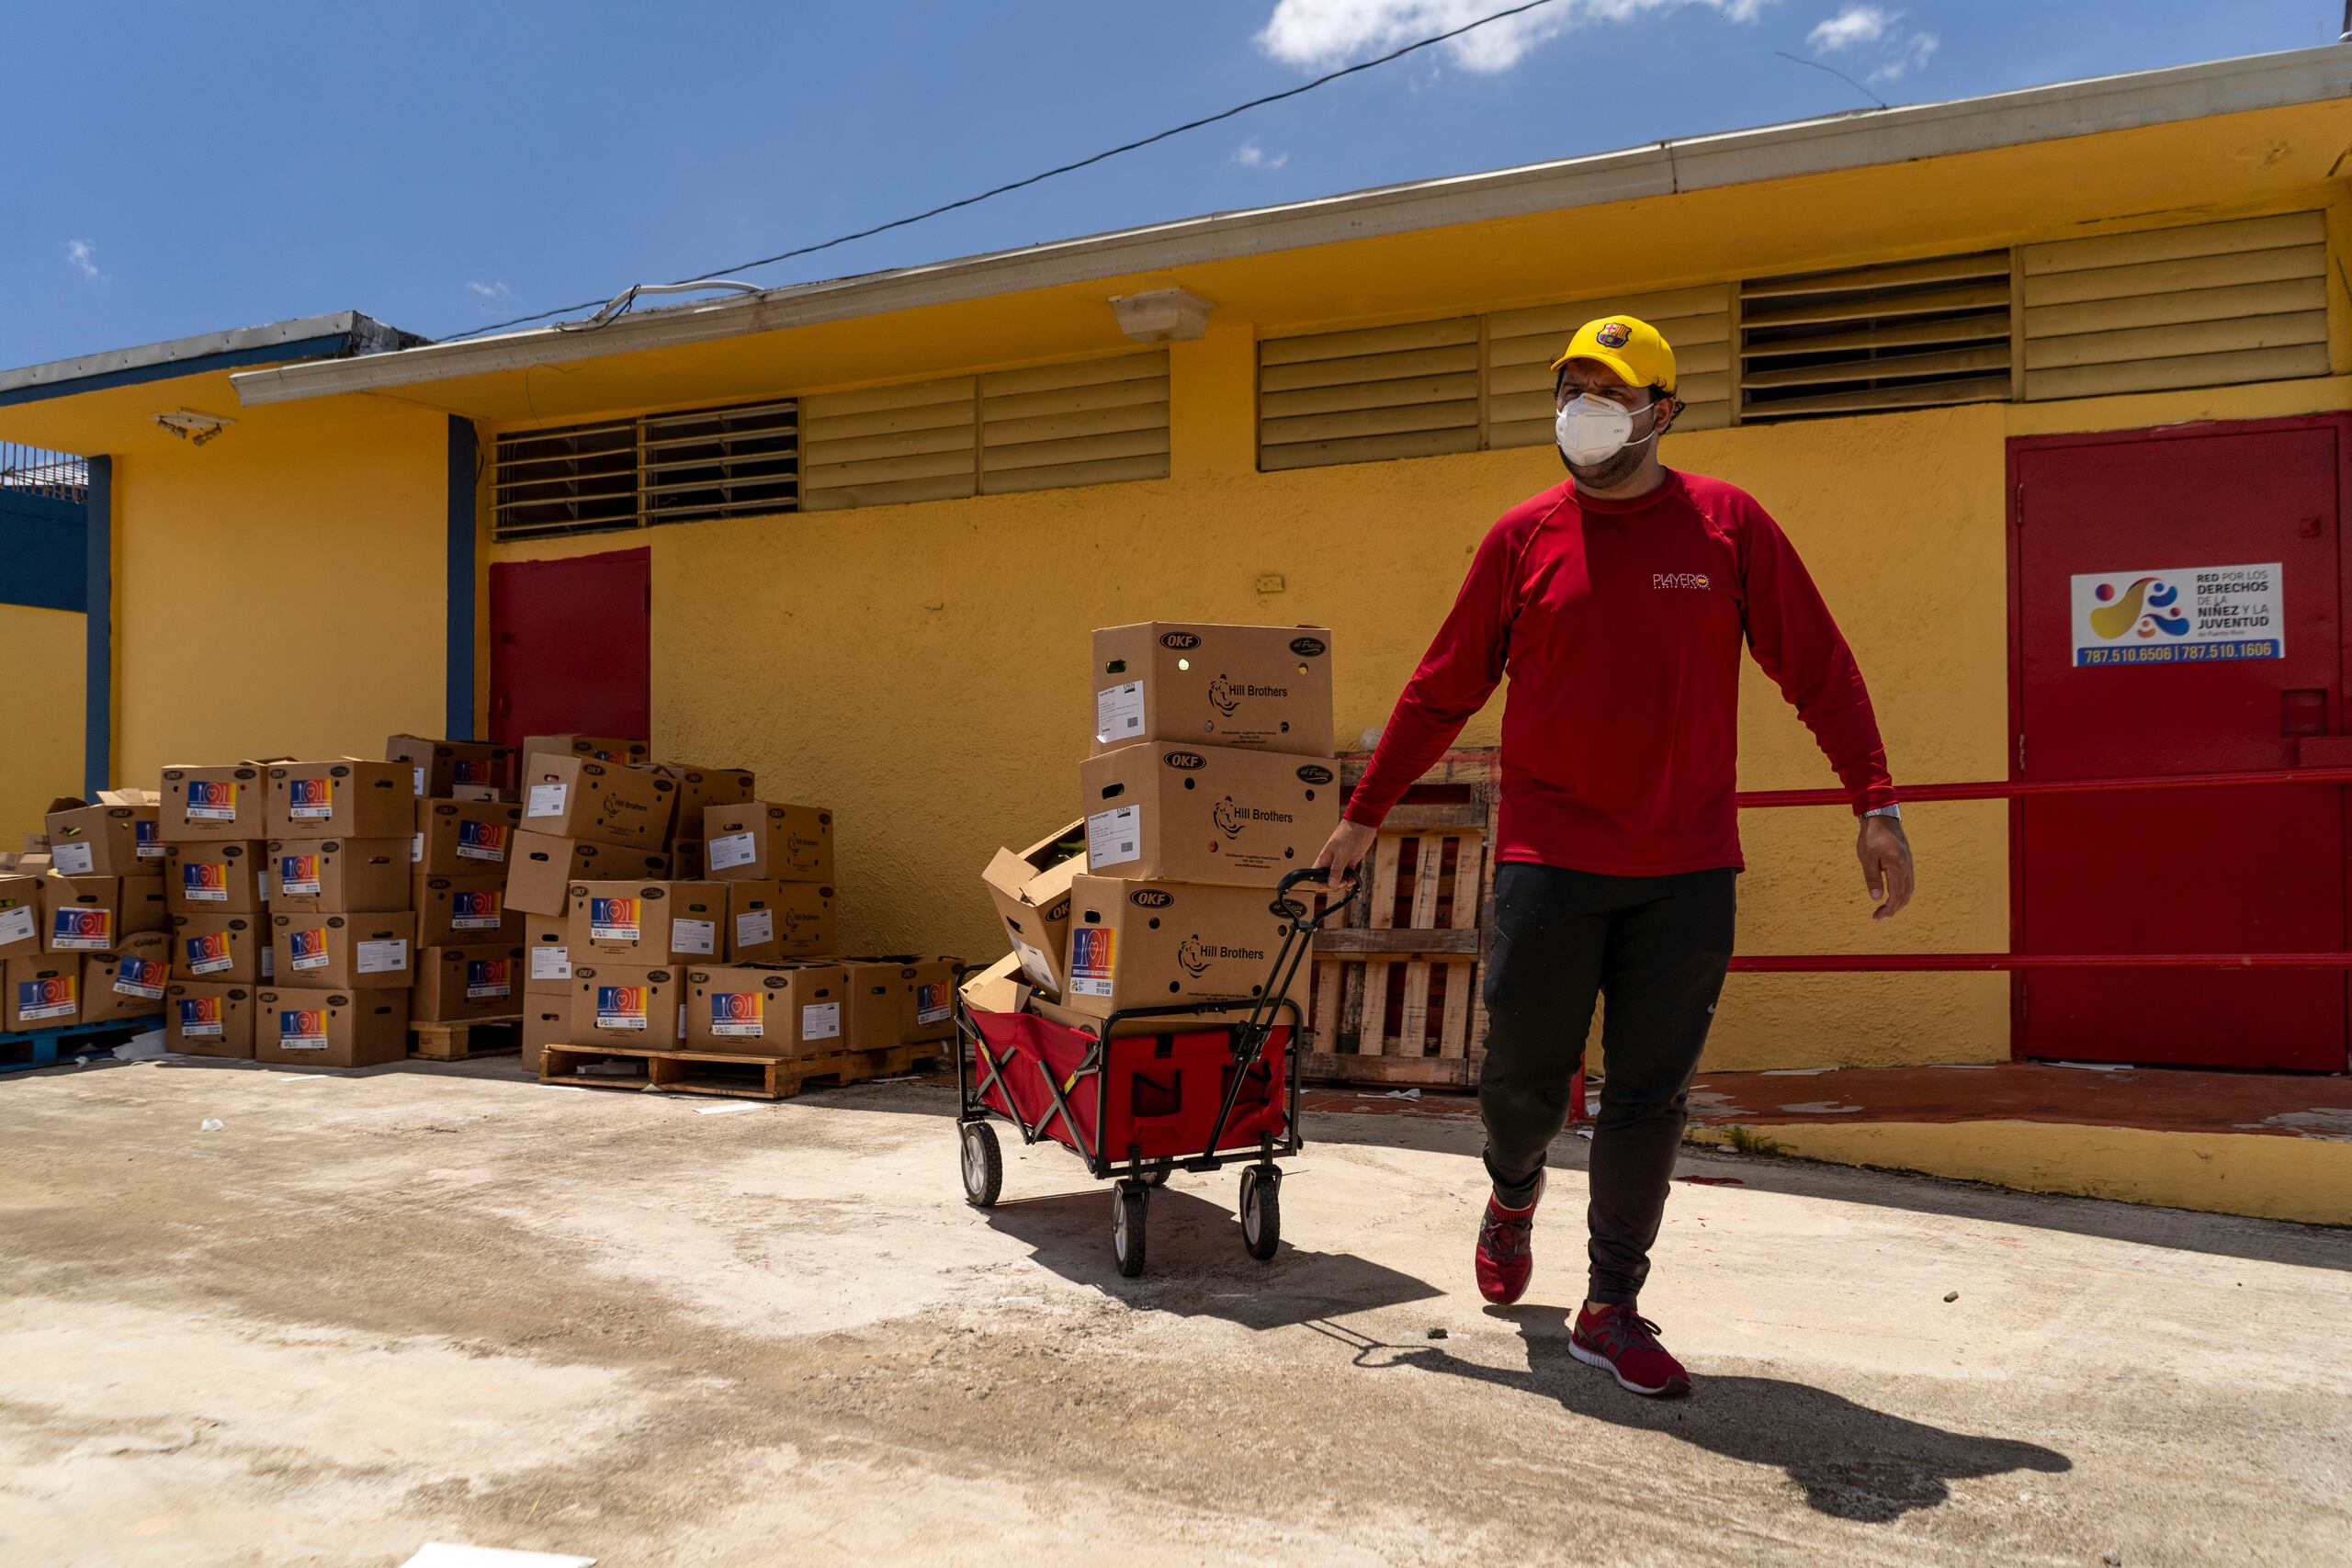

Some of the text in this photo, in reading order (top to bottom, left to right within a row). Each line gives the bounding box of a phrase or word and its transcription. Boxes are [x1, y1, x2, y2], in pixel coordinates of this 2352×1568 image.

[2197, 570, 2268, 582] RED POR LOS
[2197, 581, 2269, 595] DERECHOS
[2197, 595, 2227, 606] DE LA
[2198, 604, 2269, 617] NIÑEZ Y LA
[2197, 616, 2269, 630] JUVENTUD
[1167, 635, 1193, 648] OKF
[2085, 647, 2171, 664] 787.510.6506
[2181, 642, 2272, 660] 787.510.1606
[1228, 685, 1288, 697] Hill Brothers
[1171, 754, 1199, 767] OKF
[1234, 807, 1294, 823] Hill Brothers
[573, 887, 586, 896] OKF
[1138, 893, 1166, 906] OKF
[1200, 945, 1264, 961] Hill Brothers
[579, 969, 594, 977] OKF
[692, 974, 707, 982] OKF
